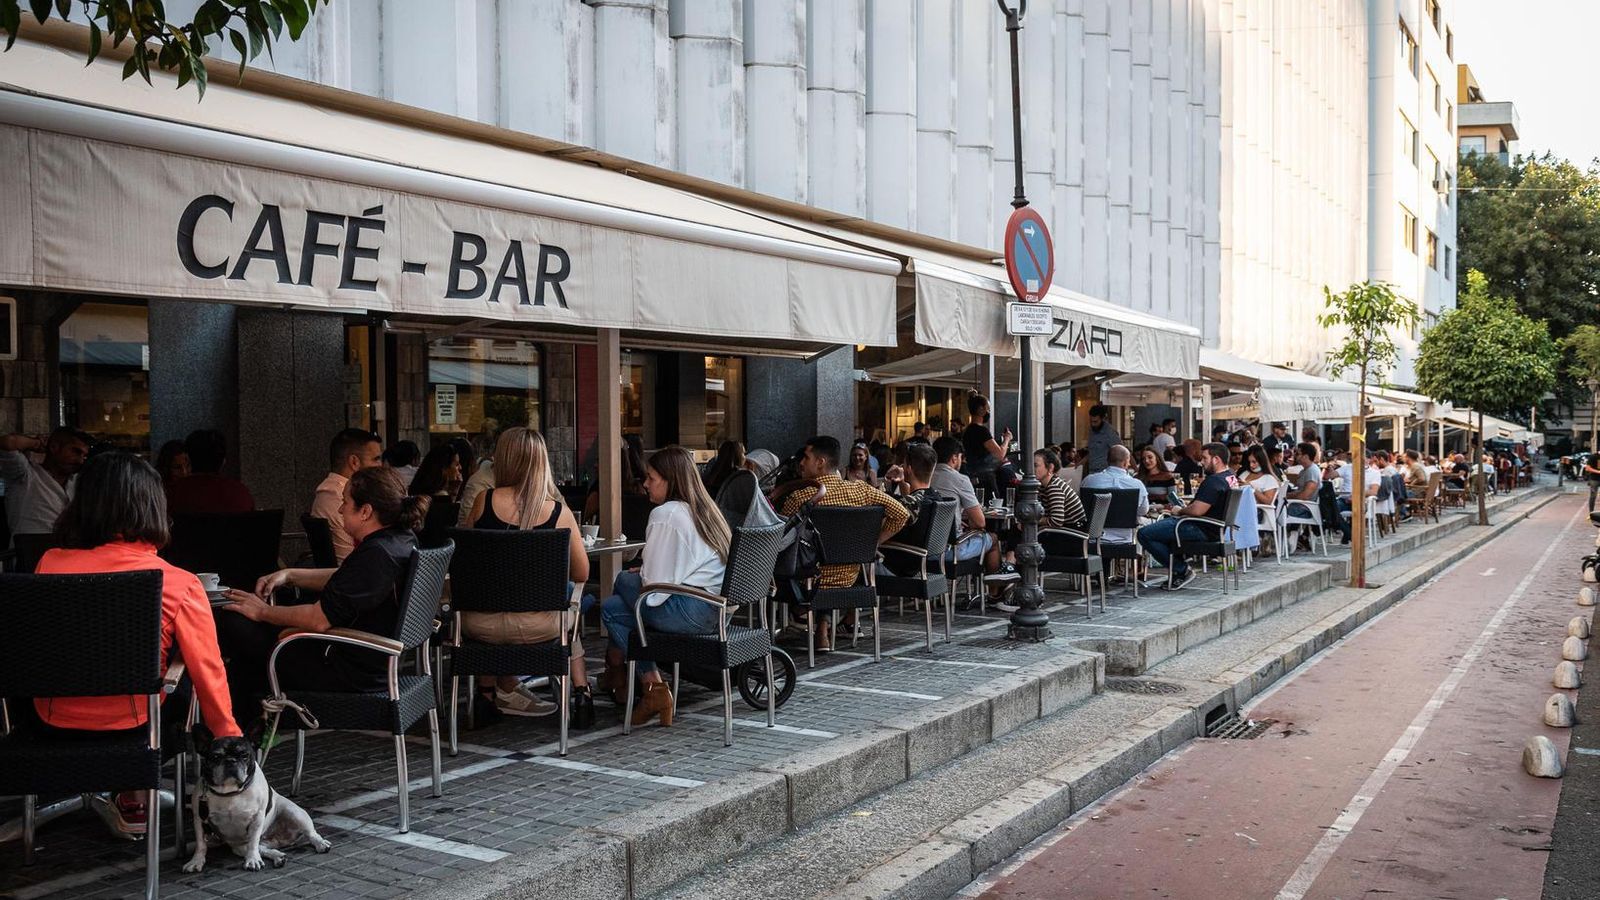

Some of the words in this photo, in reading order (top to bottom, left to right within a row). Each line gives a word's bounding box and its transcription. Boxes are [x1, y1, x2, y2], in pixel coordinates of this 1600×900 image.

[176, 193, 386, 292] CAFÉ
[401, 260, 427, 275] -
[444, 230, 571, 310] BAR
[1048, 317, 1122, 358] ZIARO
